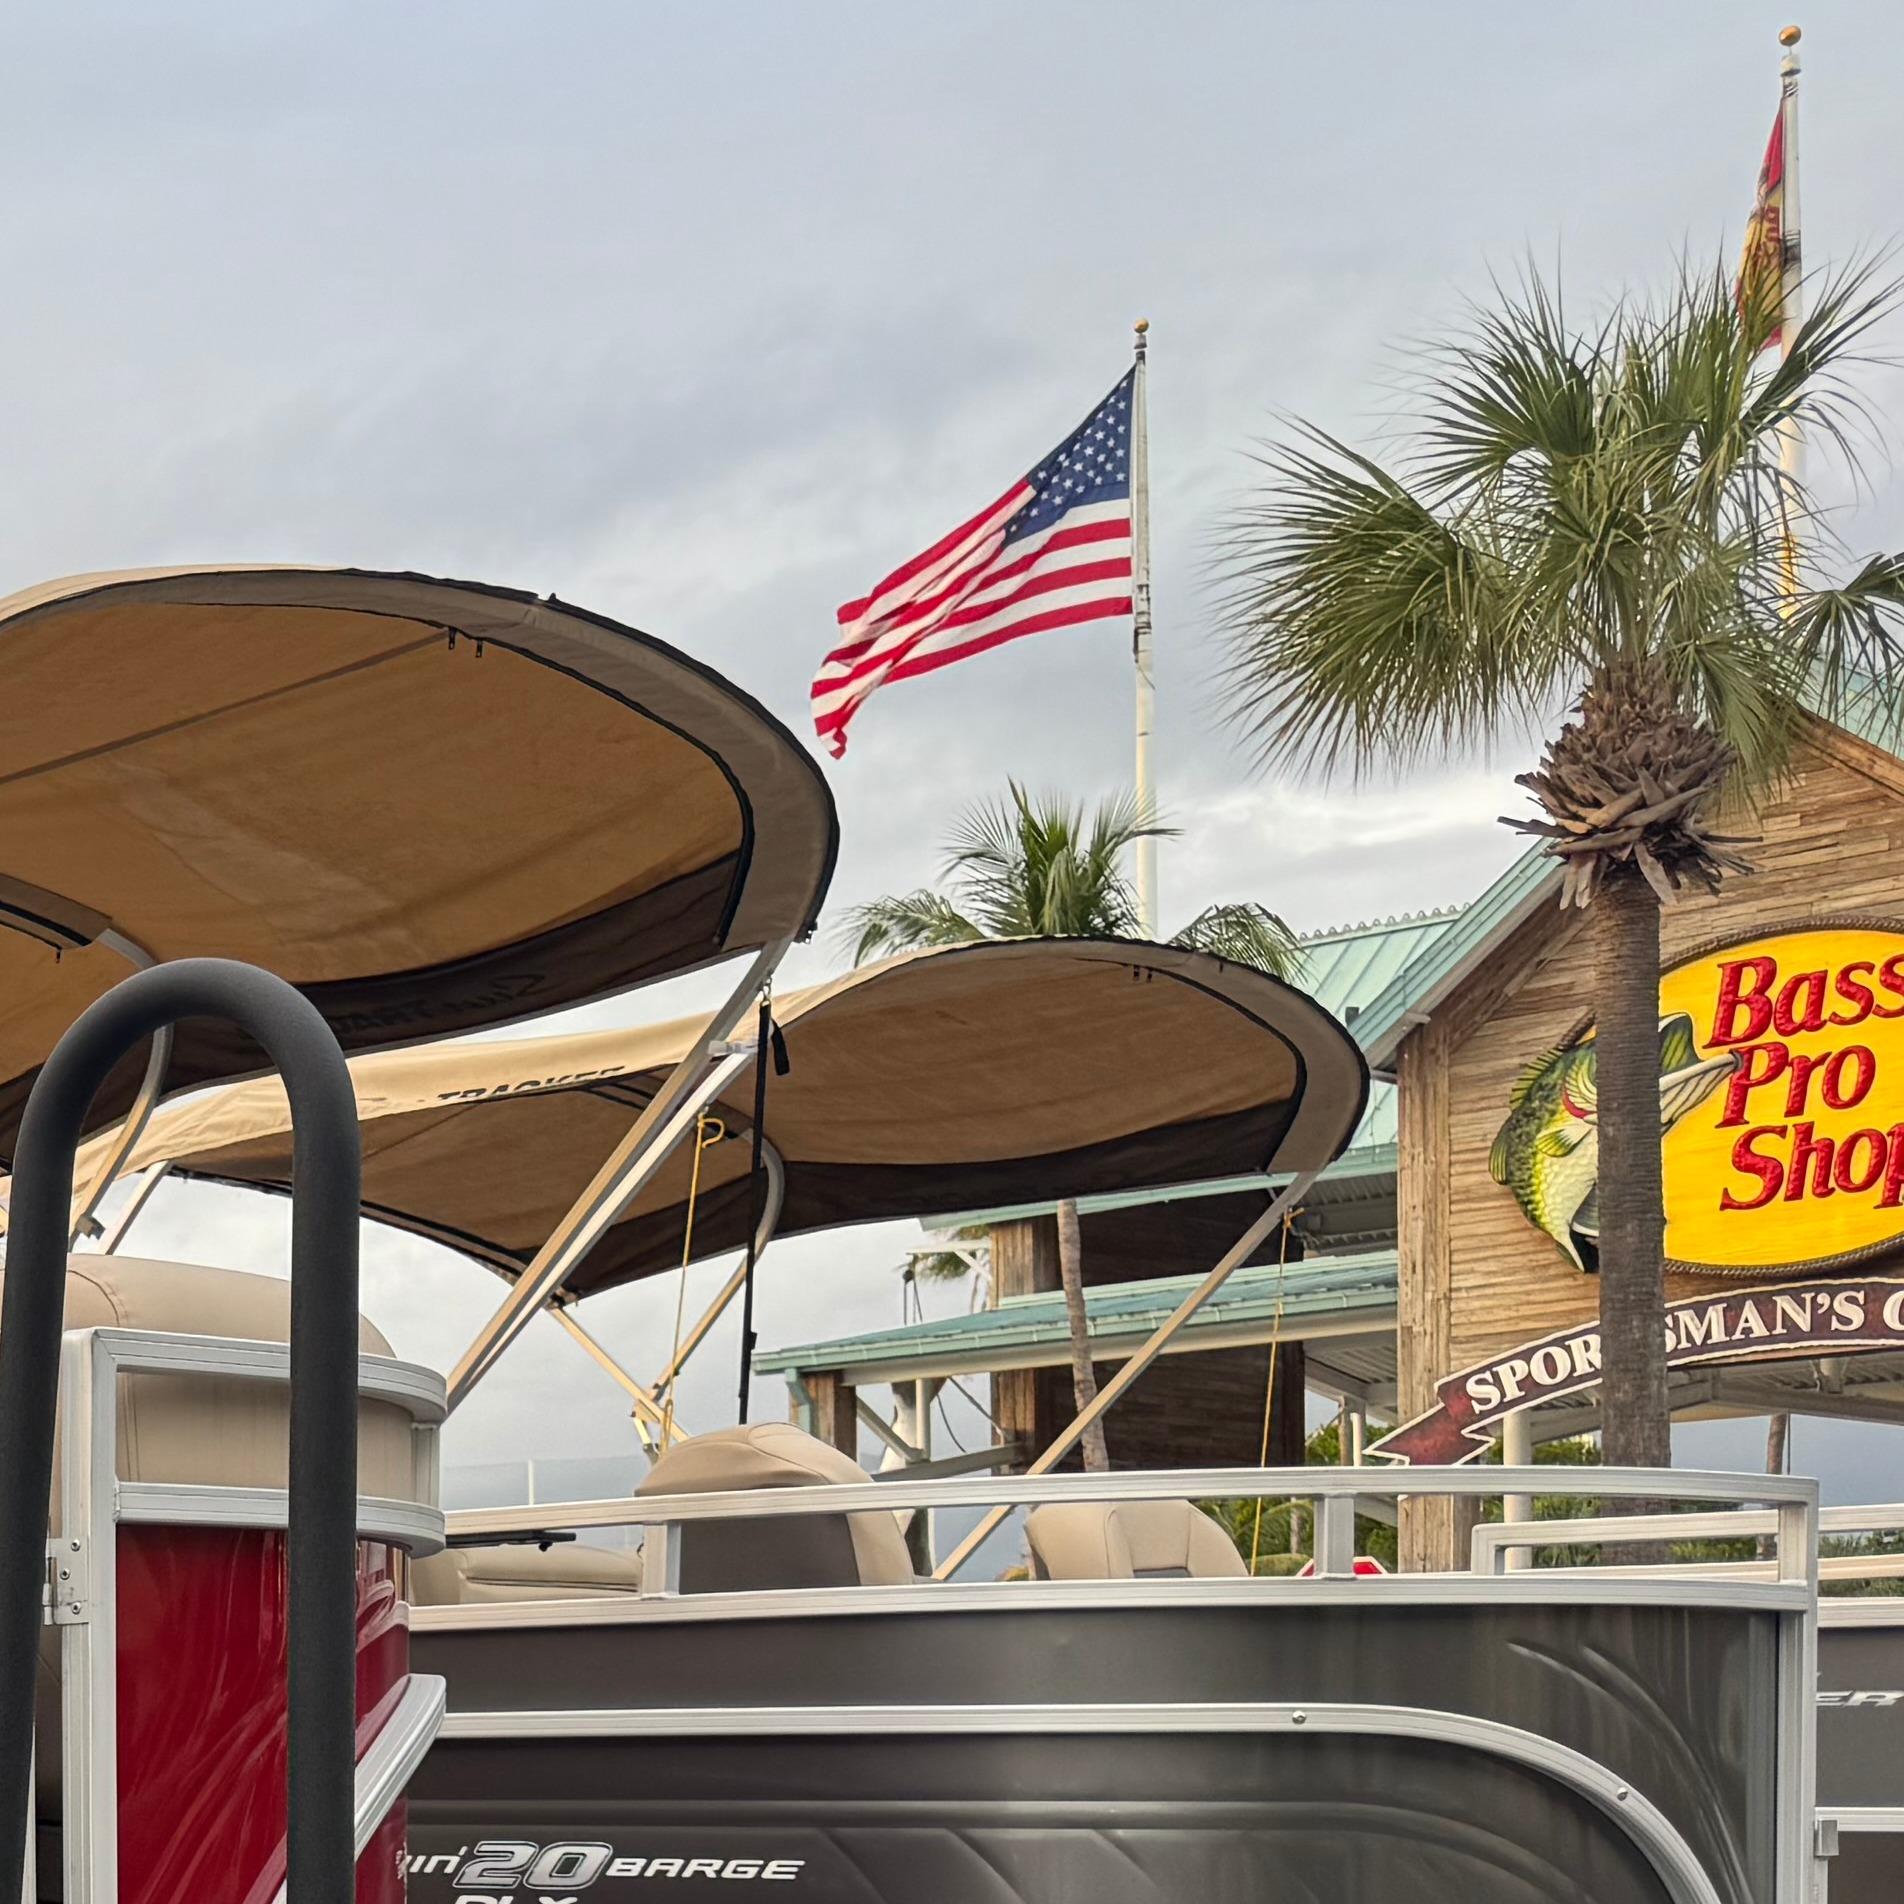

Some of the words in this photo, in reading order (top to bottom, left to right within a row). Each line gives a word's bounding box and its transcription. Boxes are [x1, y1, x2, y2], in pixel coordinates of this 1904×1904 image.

[1702, 953, 1904, 1049] Bass
[1715, 1041, 1876, 1129] Pro
[1465, 1290, 1865, 1413] SPORMAN'S
[452, 1840, 613, 1890] 20
[605, 1858, 805, 1880] BARGE
